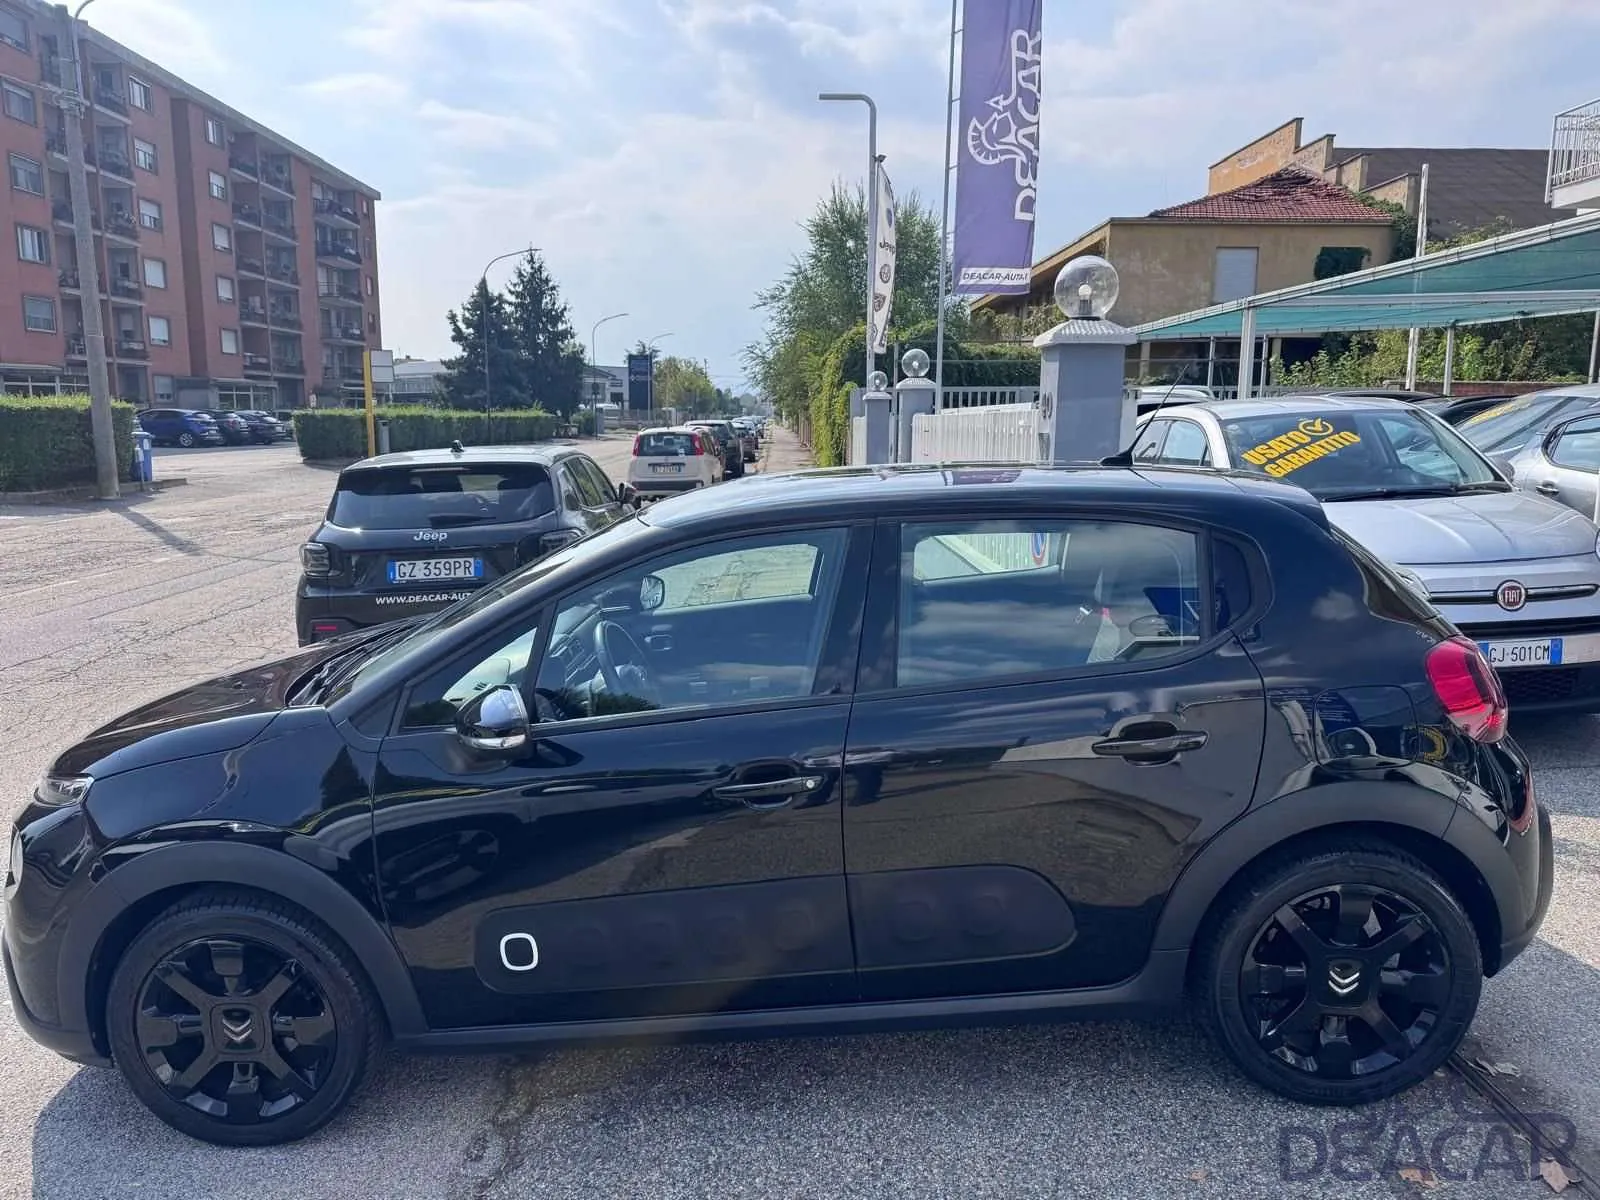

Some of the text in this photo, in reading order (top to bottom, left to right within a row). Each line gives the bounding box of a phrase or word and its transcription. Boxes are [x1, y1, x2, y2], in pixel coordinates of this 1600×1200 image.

[1241, 430, 1312, 465] USATO
[1264, 431, 1361, 478] GARANTITO
[413, 531, 448, 542] Jeep
[398, 560, 472, 578] GZ 359PR
[1504, 590, 1521, 603] FIAT
